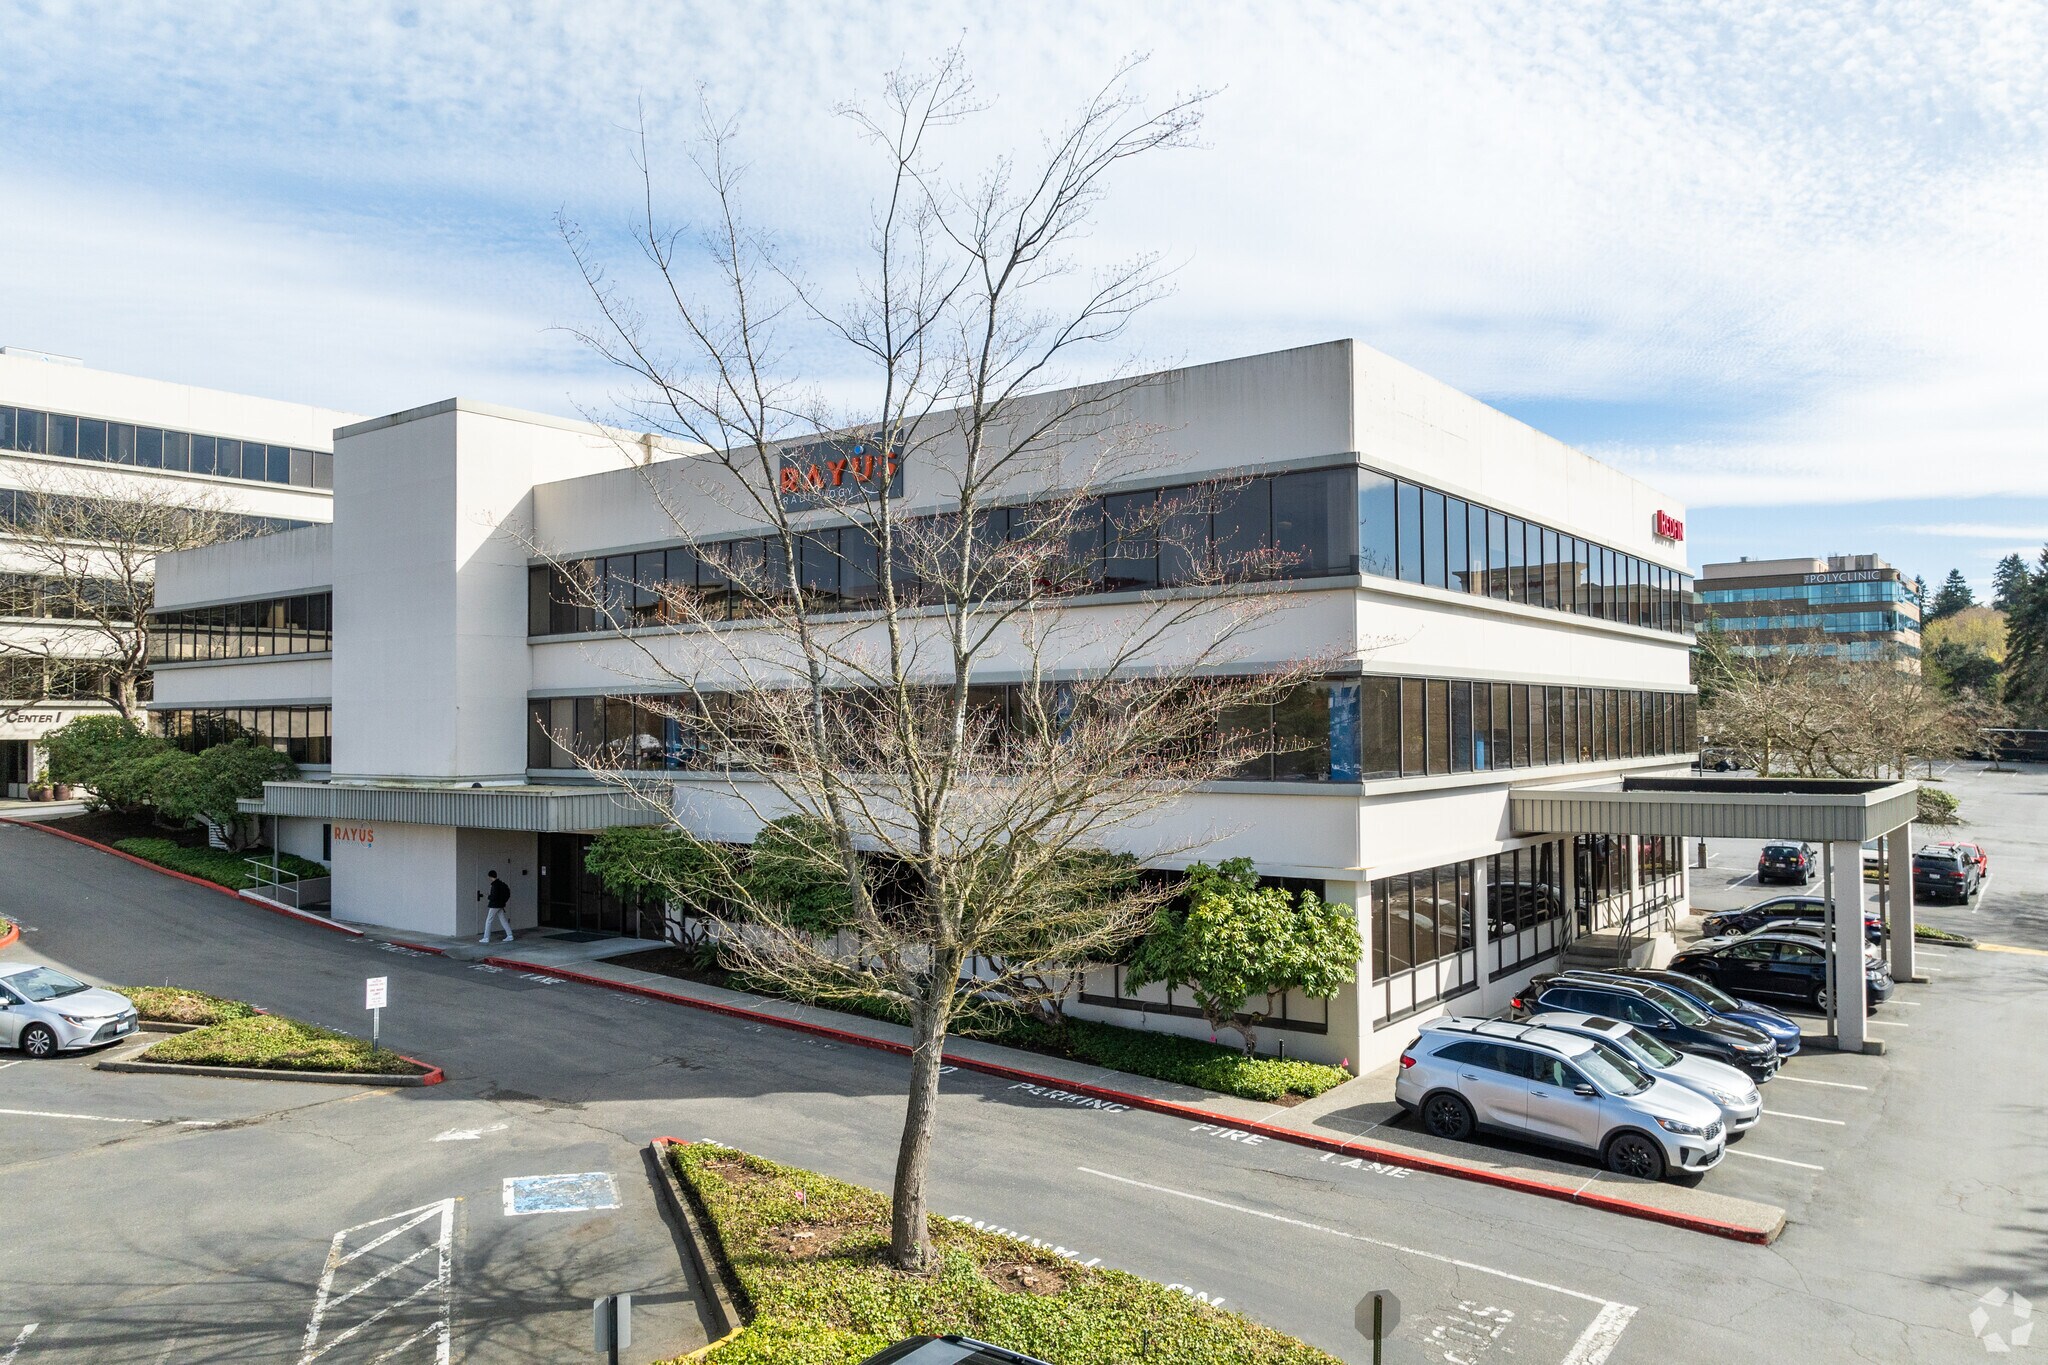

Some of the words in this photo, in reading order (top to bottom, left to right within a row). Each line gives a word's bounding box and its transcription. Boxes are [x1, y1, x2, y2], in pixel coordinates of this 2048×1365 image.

[1810, 570, 1880, 583] POLYCLINIC
[334, 826, 374, 843] RAYUS
[1007, 1082, 1130, 1113] PARKING
[1188, 1123, 1270, 1146] FIRE
[1319, 1152, 1414, 1179] LANE
